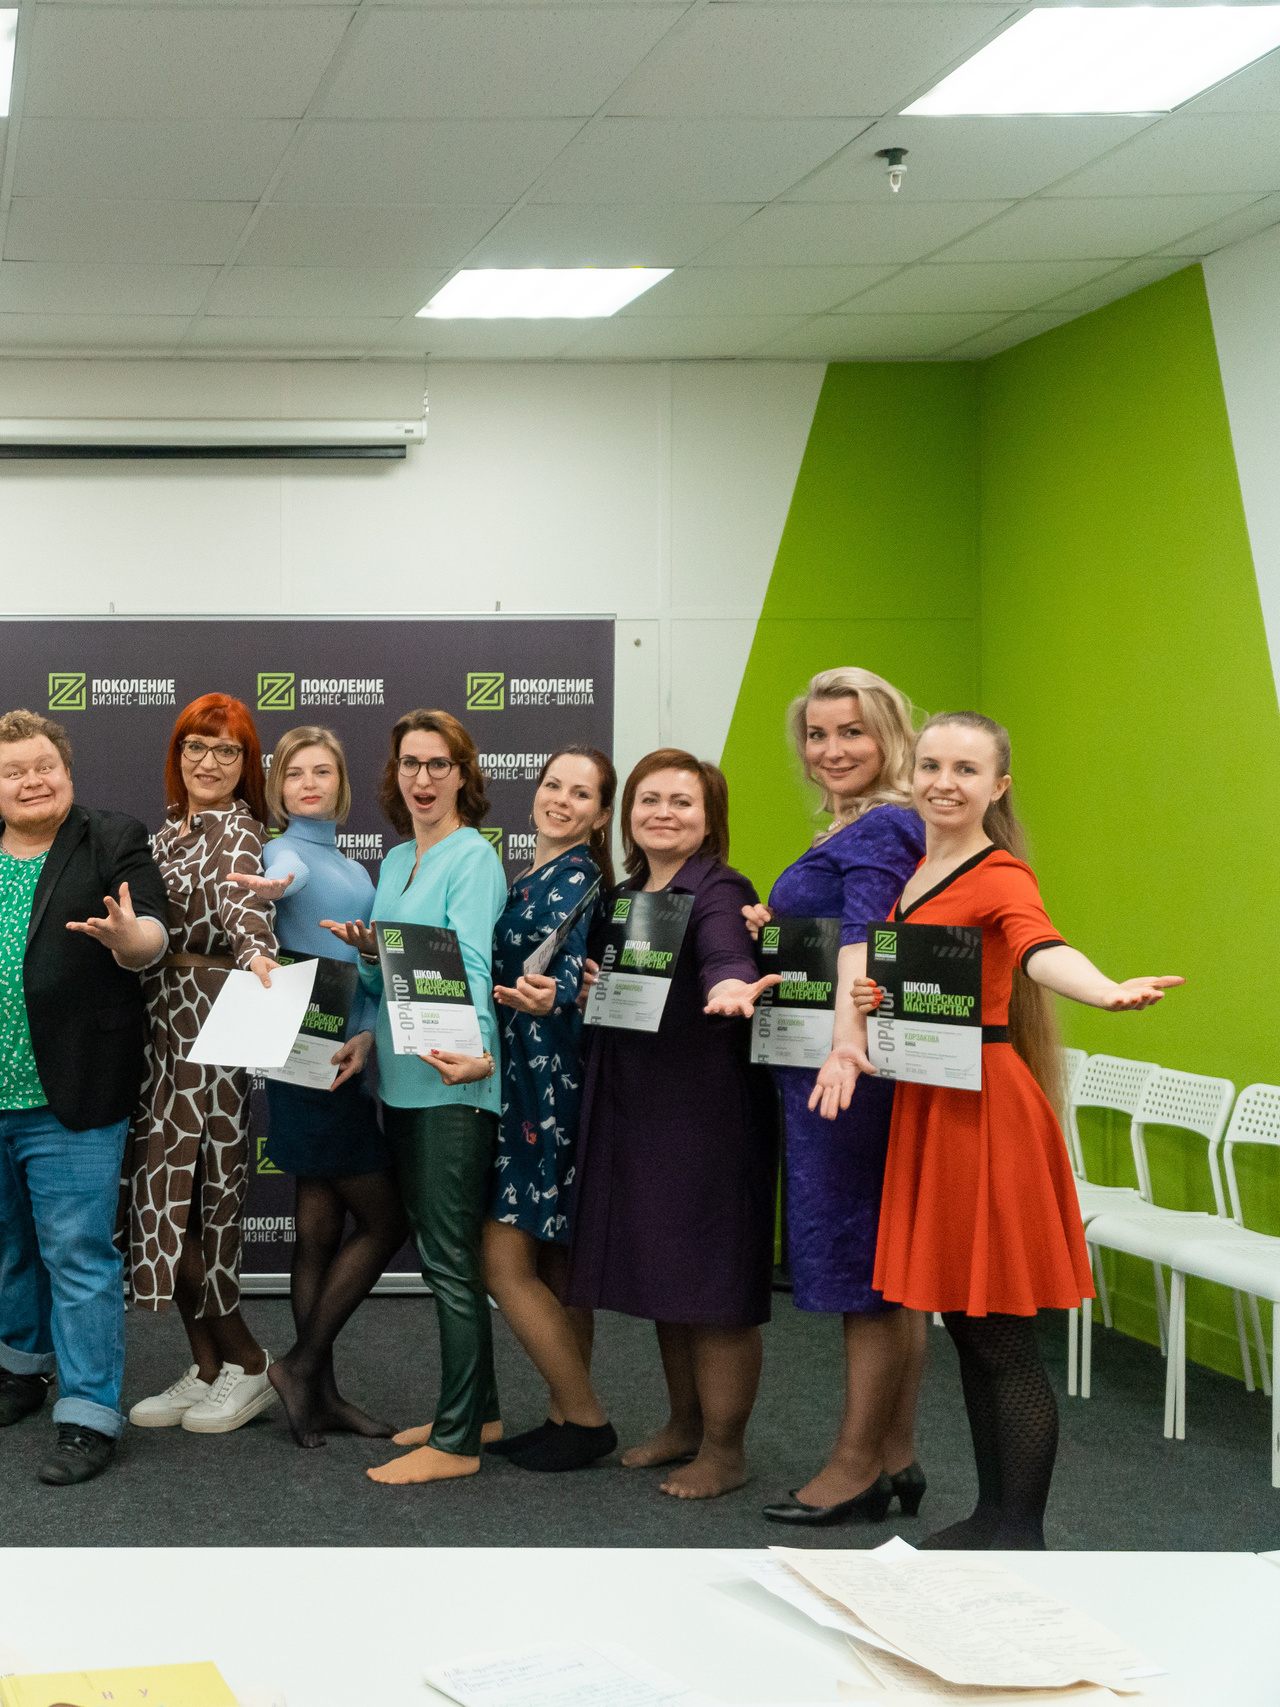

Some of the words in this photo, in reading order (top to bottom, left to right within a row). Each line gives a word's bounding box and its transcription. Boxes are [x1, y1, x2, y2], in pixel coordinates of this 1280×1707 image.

[92, 679, 176, 693] ПОКОЛЕНИЕ
[300, 679, 384, 693] ПОКОЛЕНИЕ
[510, 679, 594, 693] ПОКОЛЕНИЕ
[92, 693, 177, 706] БИЗНЕС-ШКОЛА
[301, 693, 385, 706] БИЗНЕС-ШКОЛА
[510, 693, 595, 705] БИЗНЕС-ШКОЛА
[478, 753, 552, 768] ПОКОЛЕН
[335, 834, 383, 848] ЛЕНИЕ
[413, 969, 442, 980] ШКОЛА
[903, 981, 941, 995] ШКОЛА
[243, 1217, 296, 1230] ОКОЛЕ
[244, 1231, 297, 1242] ИЗНЕС-Ш
